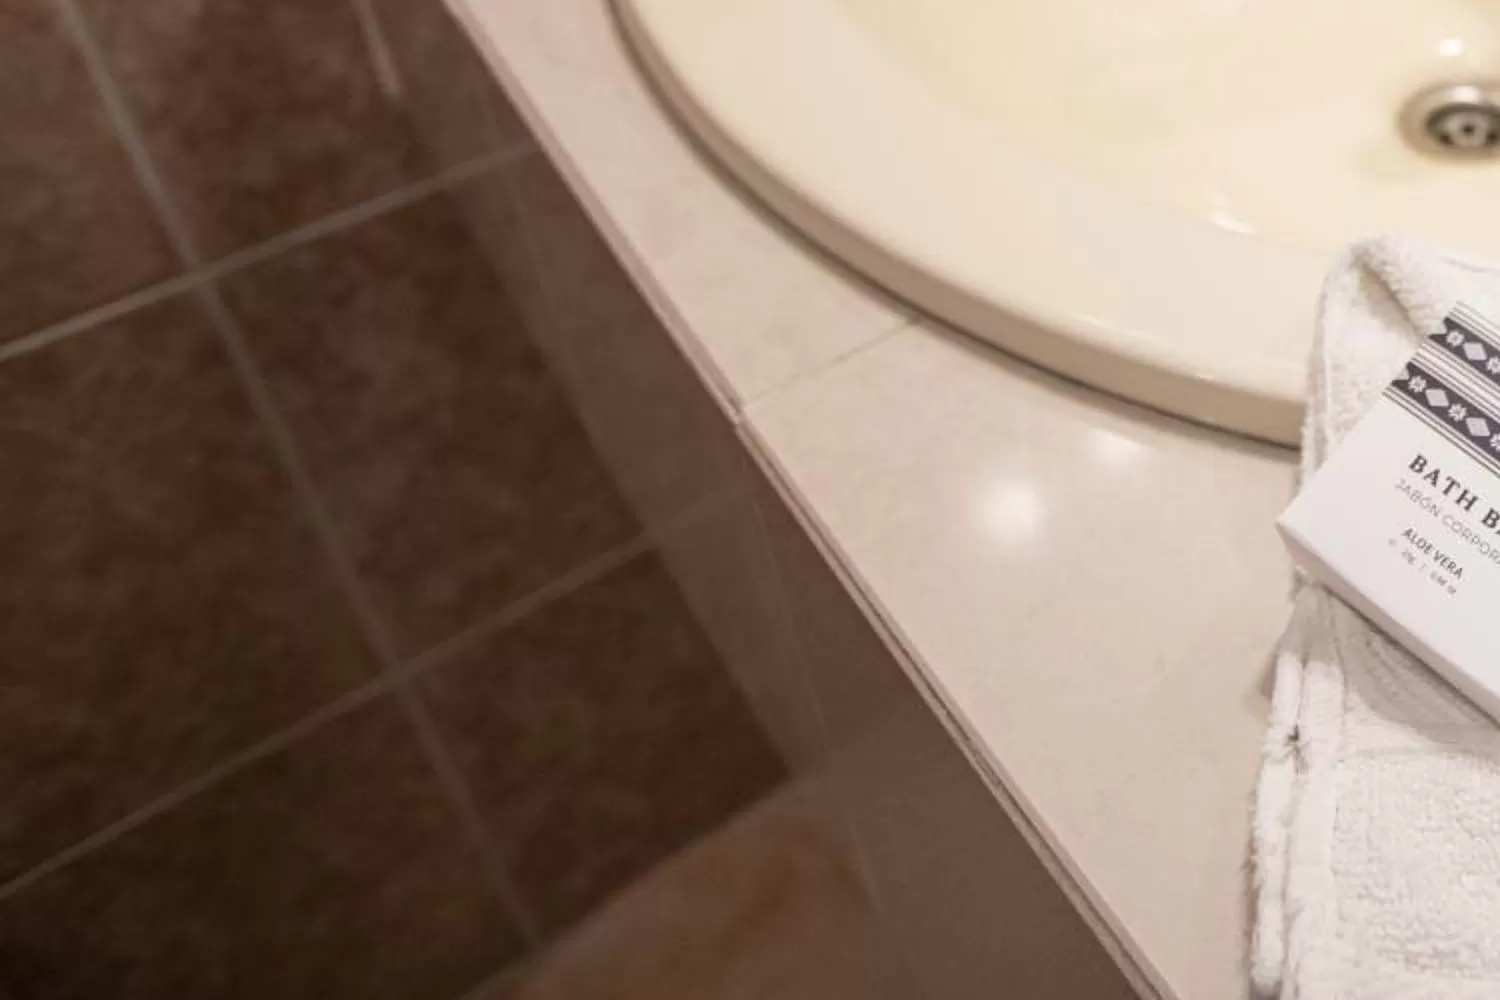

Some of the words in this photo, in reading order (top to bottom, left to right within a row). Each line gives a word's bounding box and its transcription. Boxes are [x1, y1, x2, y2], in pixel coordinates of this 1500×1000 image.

[1408, 453, 1479, 512] BATH
[1402, 528, 1434, 555] ALOE
[1433, 550, 1464, 580] VERA
